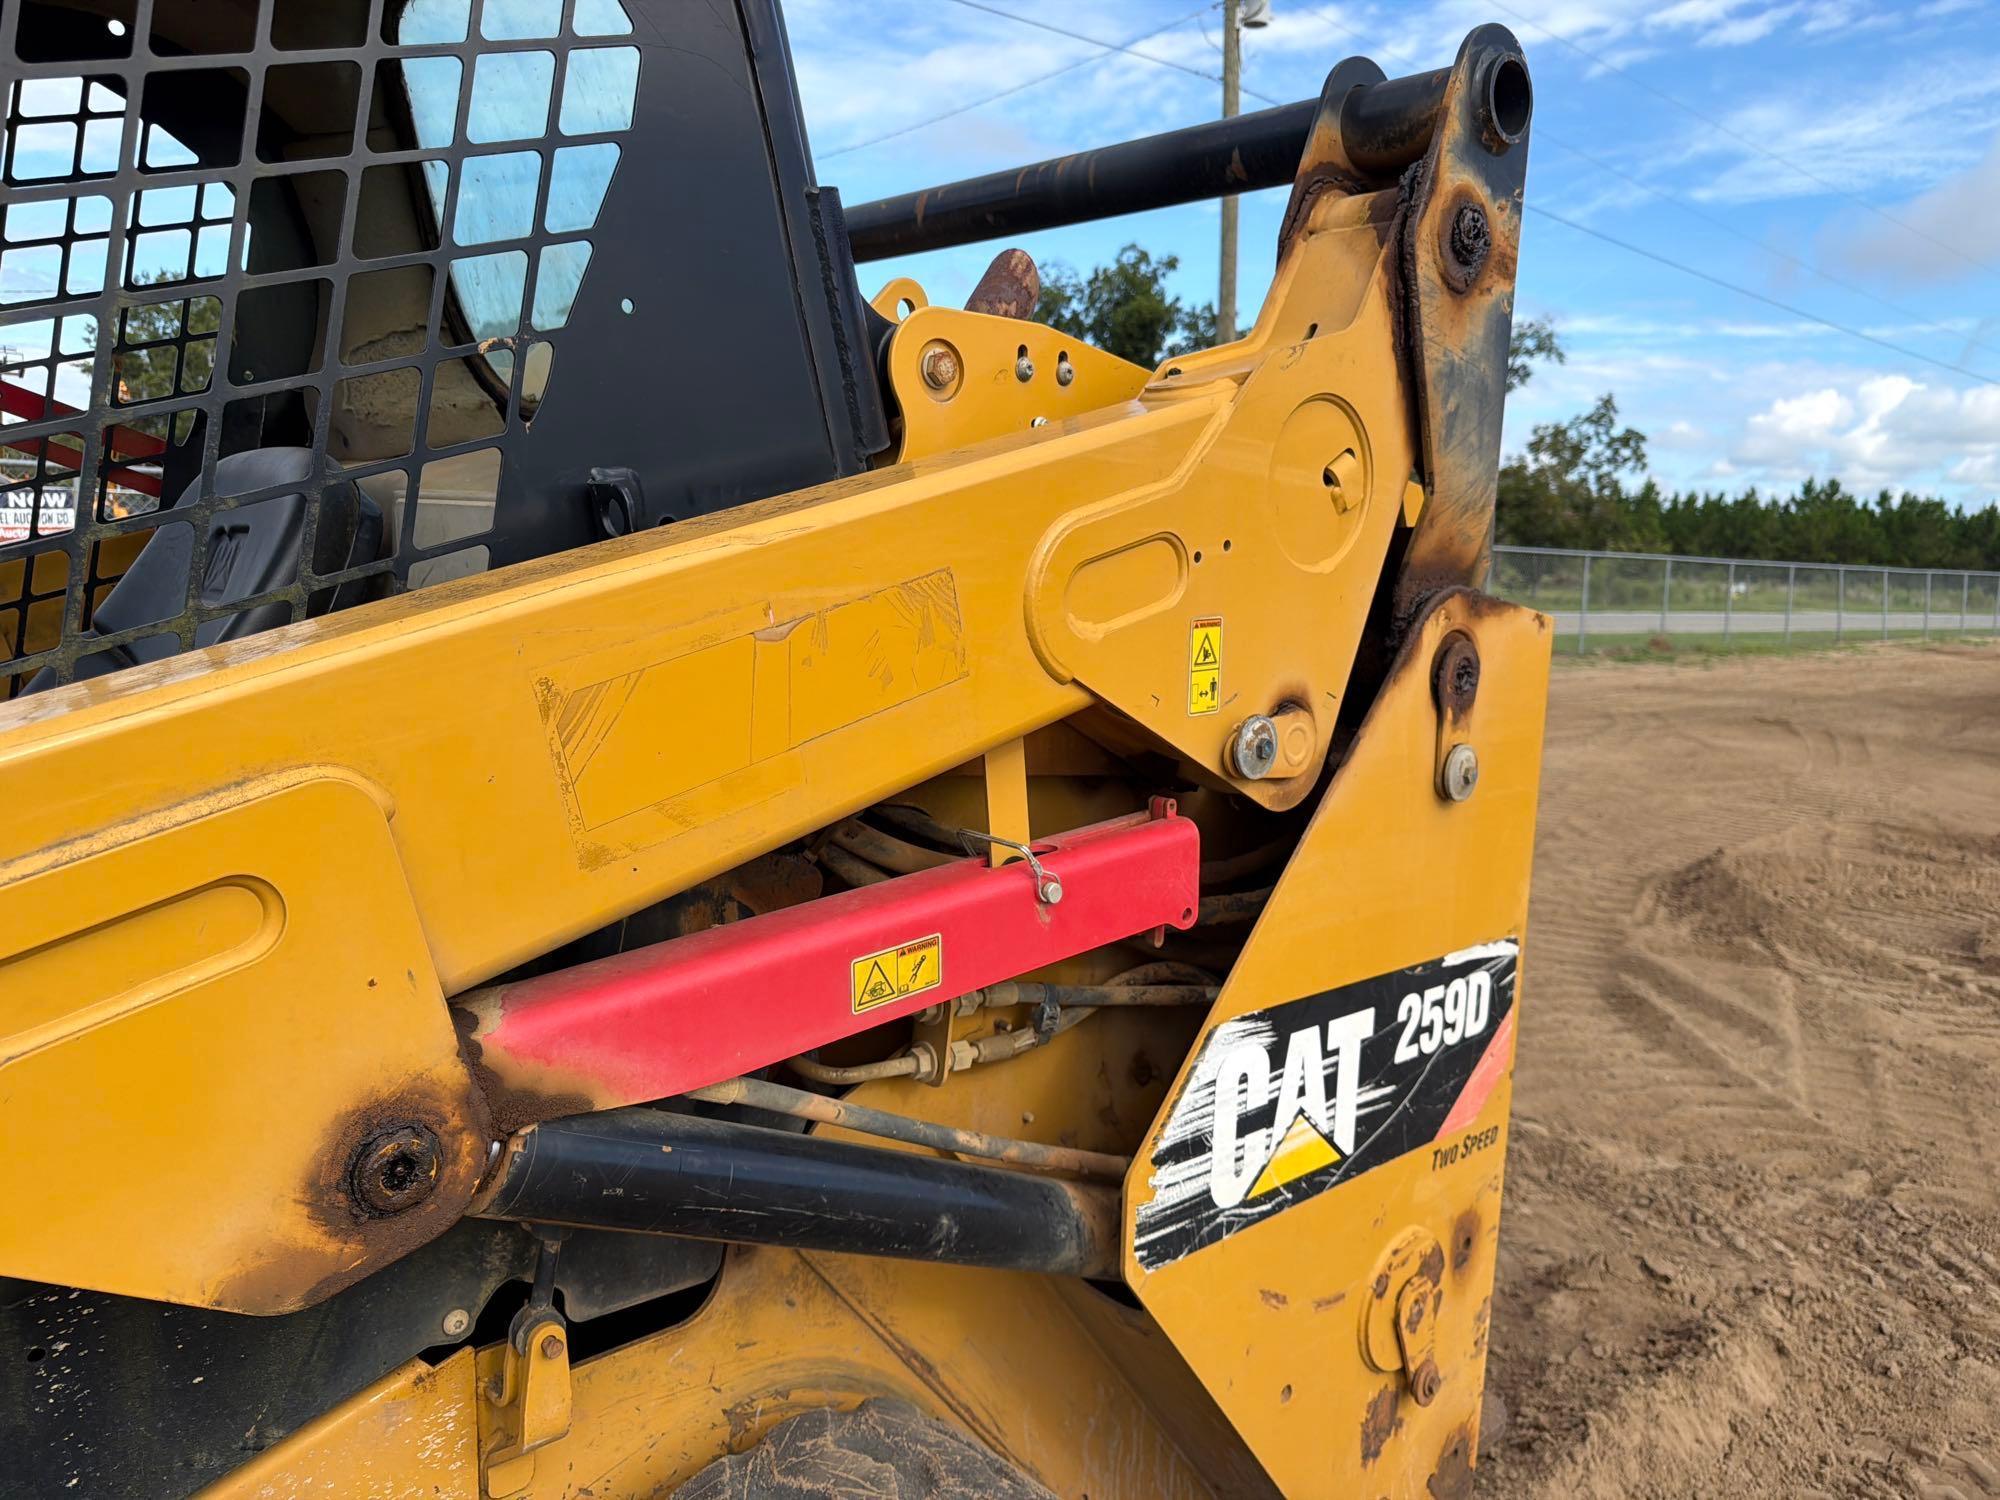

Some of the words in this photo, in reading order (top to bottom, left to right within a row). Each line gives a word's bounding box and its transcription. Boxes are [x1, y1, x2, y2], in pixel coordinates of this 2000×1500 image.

[14, 512, 53, 524] AUCON
[907, 939, 937, 954] WARNING
[1393, 970, 1492, 1065] 259D
[1209, 1006, 1376, 1209] CAT
[1432, 1144, 1459, 1172] TWO
